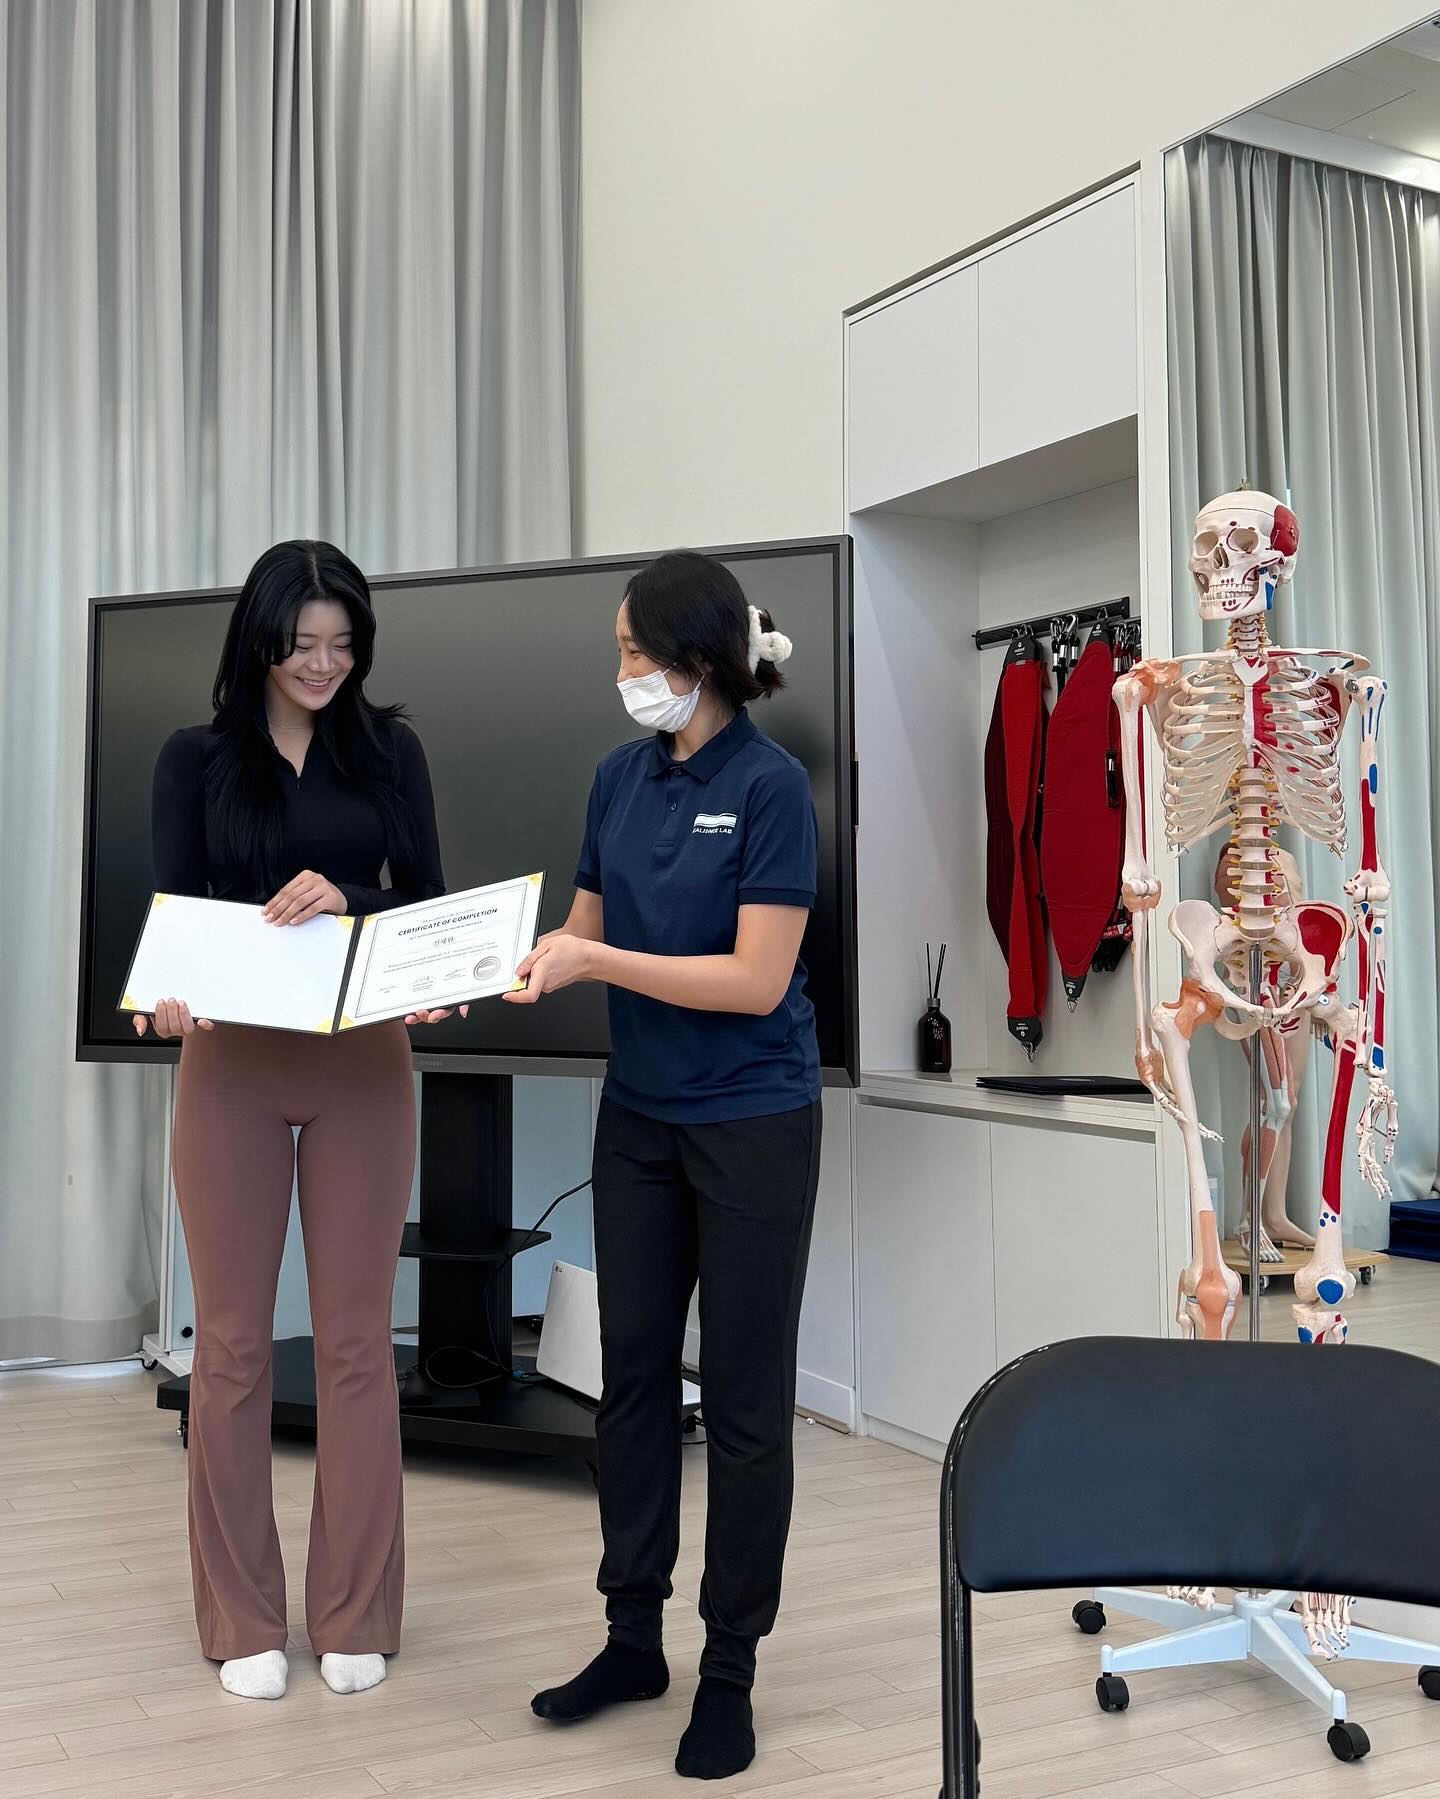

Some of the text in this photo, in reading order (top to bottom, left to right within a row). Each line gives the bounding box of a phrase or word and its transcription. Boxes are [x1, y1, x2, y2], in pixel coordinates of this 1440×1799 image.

[398, 921, 441, 936] CERTIFICATE
[441, 918, 451, 926] OF
[452, 908, 498, 923] COMPLETION
